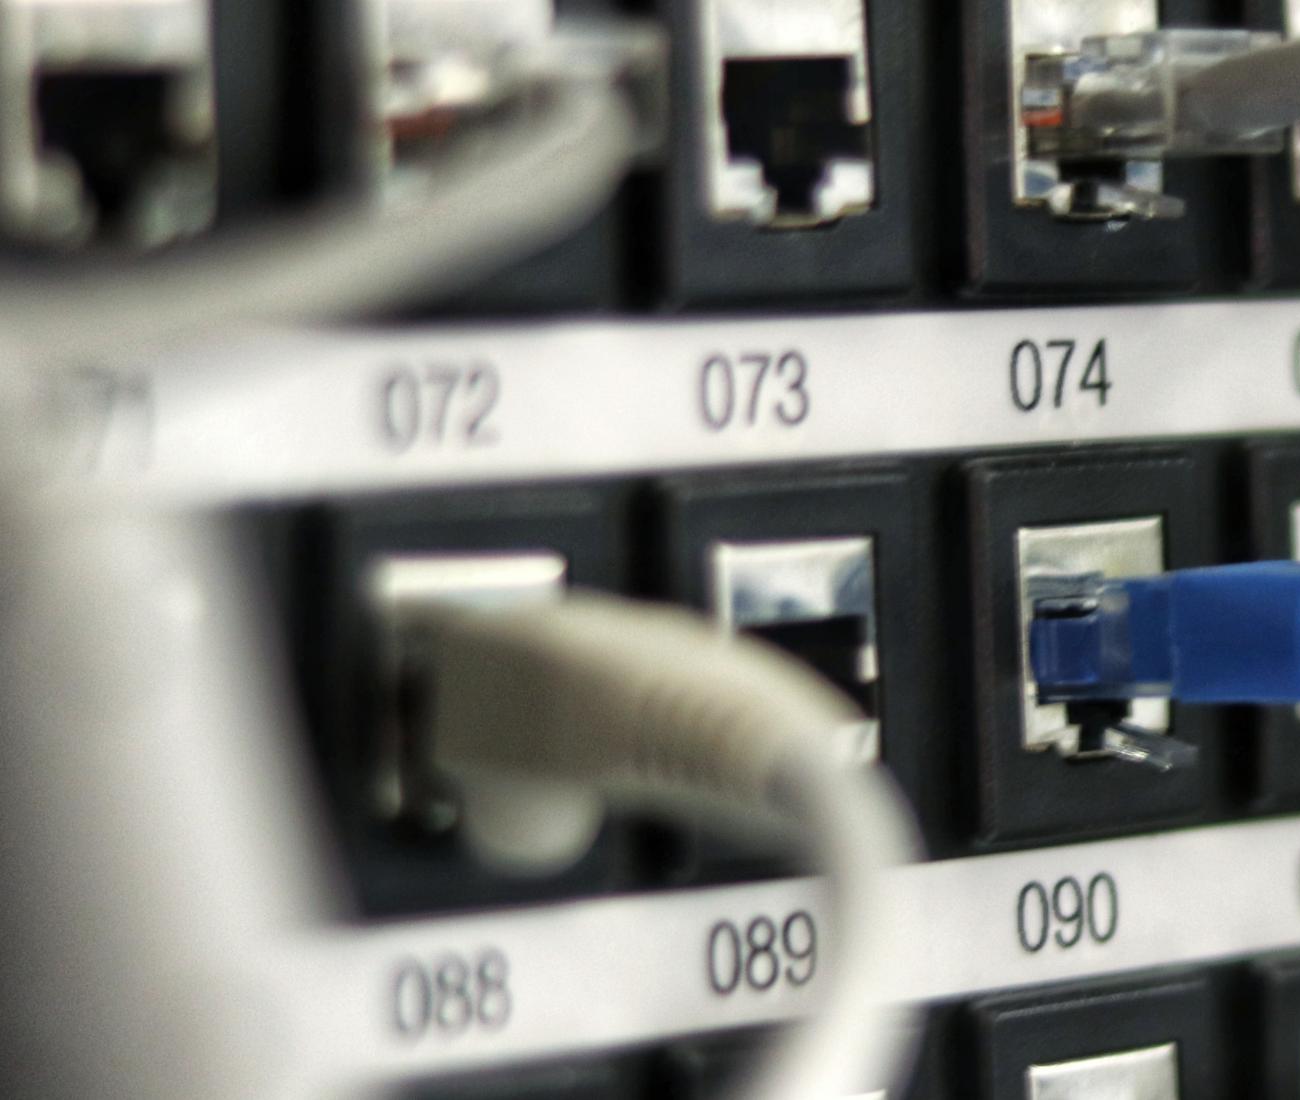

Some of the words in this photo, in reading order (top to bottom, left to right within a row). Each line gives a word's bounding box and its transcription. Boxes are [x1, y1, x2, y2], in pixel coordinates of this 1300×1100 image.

[376, 360, 500, 454] 072
[697, 349, 811, 431] 073
[1008, 337, 1113, 412] 074
[390, 944, 510, 1041] 088
[706, 908, 818, 998] 089
[1015, 871, 1119, 954] 090
